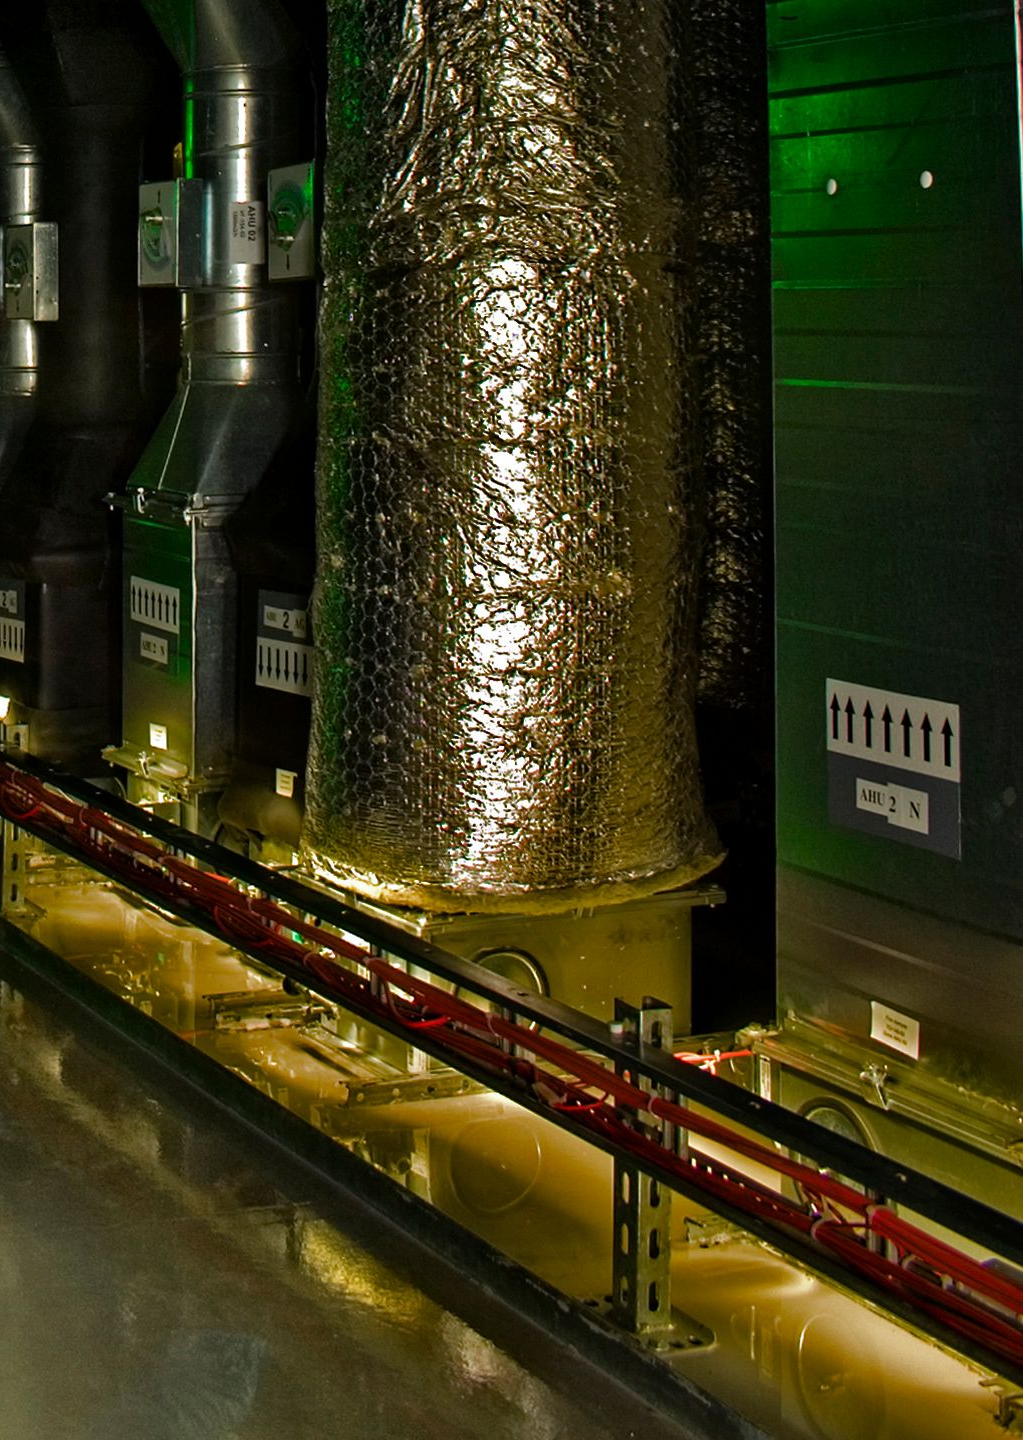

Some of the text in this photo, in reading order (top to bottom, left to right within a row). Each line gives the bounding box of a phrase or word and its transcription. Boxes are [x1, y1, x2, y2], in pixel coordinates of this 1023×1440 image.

[248, 205, 256, 241] AHU 02
[283, 611, 289, 629] 2
[861, 788, 921, 820] AHU 2 N
